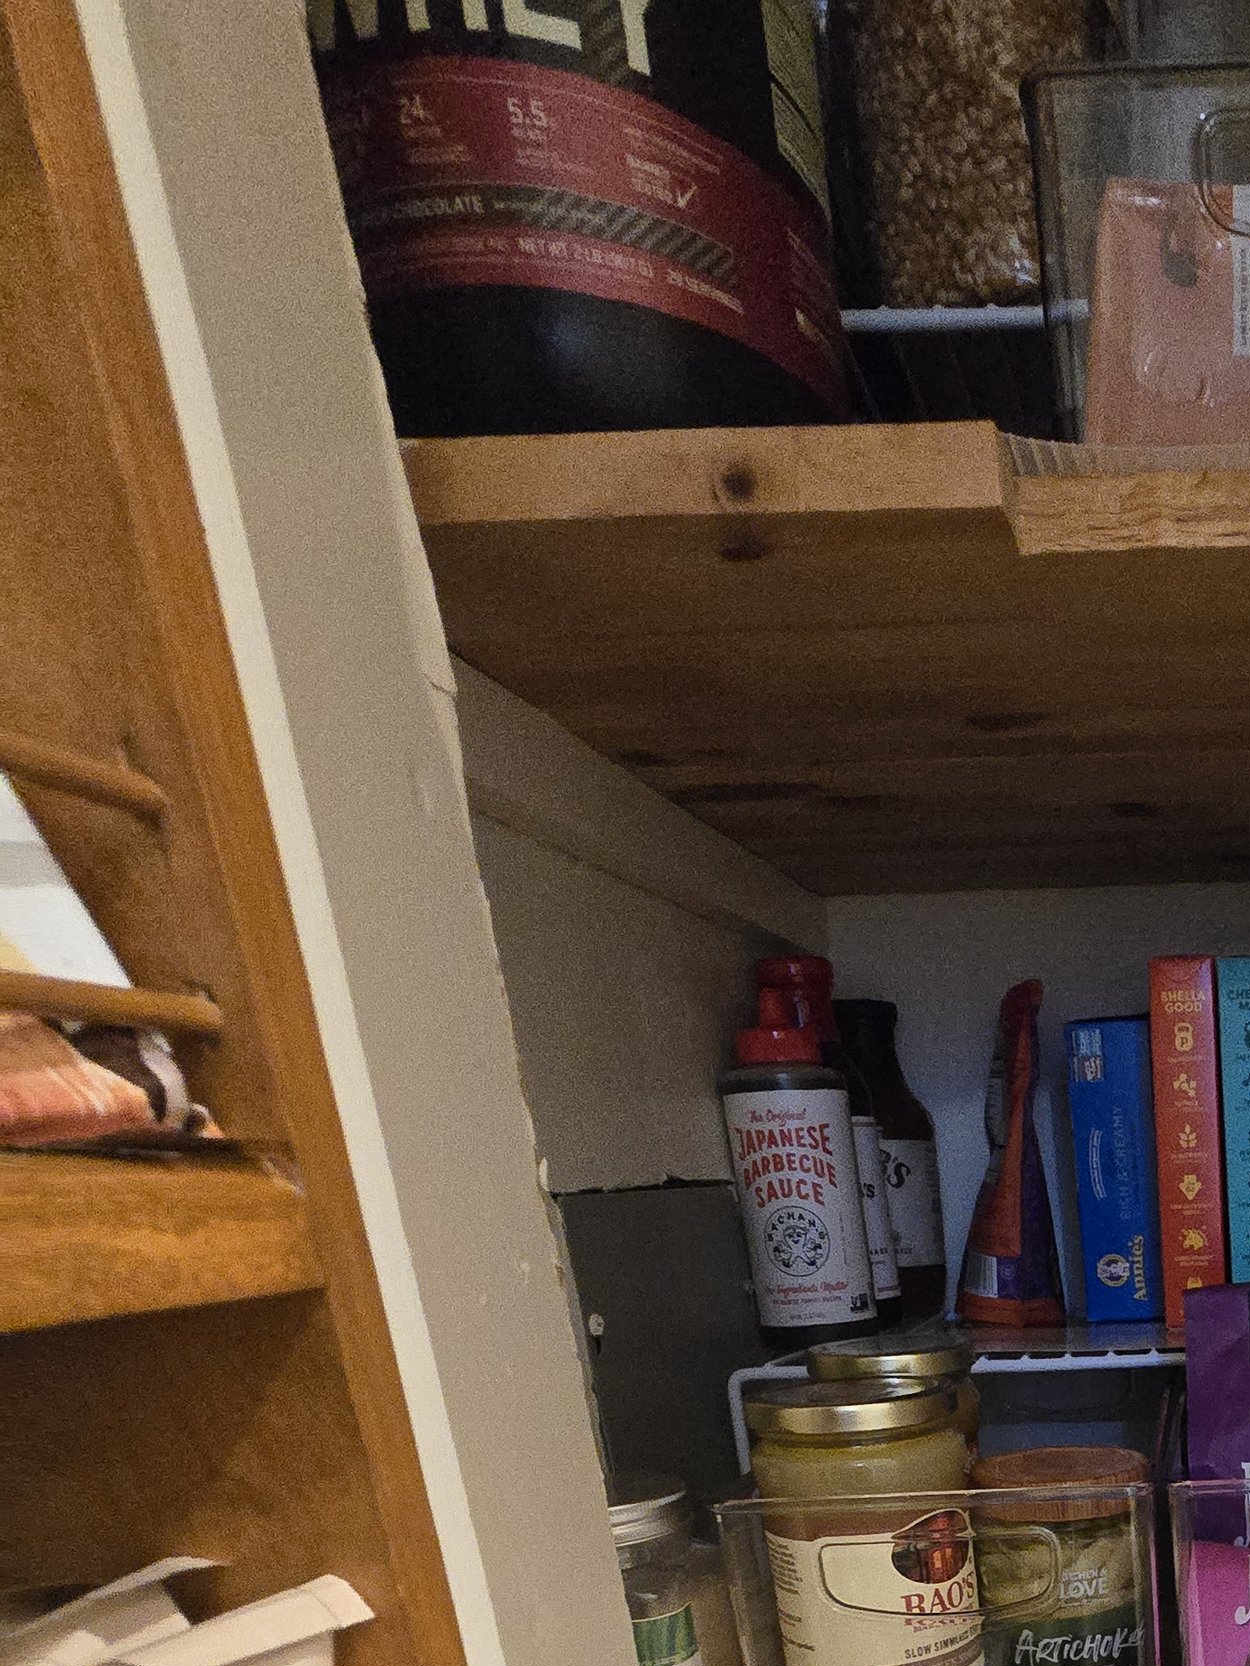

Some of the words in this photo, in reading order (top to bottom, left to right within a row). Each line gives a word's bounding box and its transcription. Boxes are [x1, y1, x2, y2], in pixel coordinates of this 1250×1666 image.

[505, 96, 548, 128] 5.5
[1164, 1001, 1202, 1013] GOOD
[735, 1123, 833, 1161] JAPANESE
[1111, 1104, 1129, 1165] CREAMY
[743, 1153, 838, 1190] BARBECUE
[754, 1177, 825, 1207] SAUCE
[1118, 1186, 1131, 1221] RICH
[767, 1212, 826, 1241] BACHAN'S
[1127, 1234, 1149, 1303] Annie's
[900, 1571, 976, 1624] RAO'S
[1058, 1576, 1110, 1599] LOVE
[904, 1643, 933, 1660] SLOW
